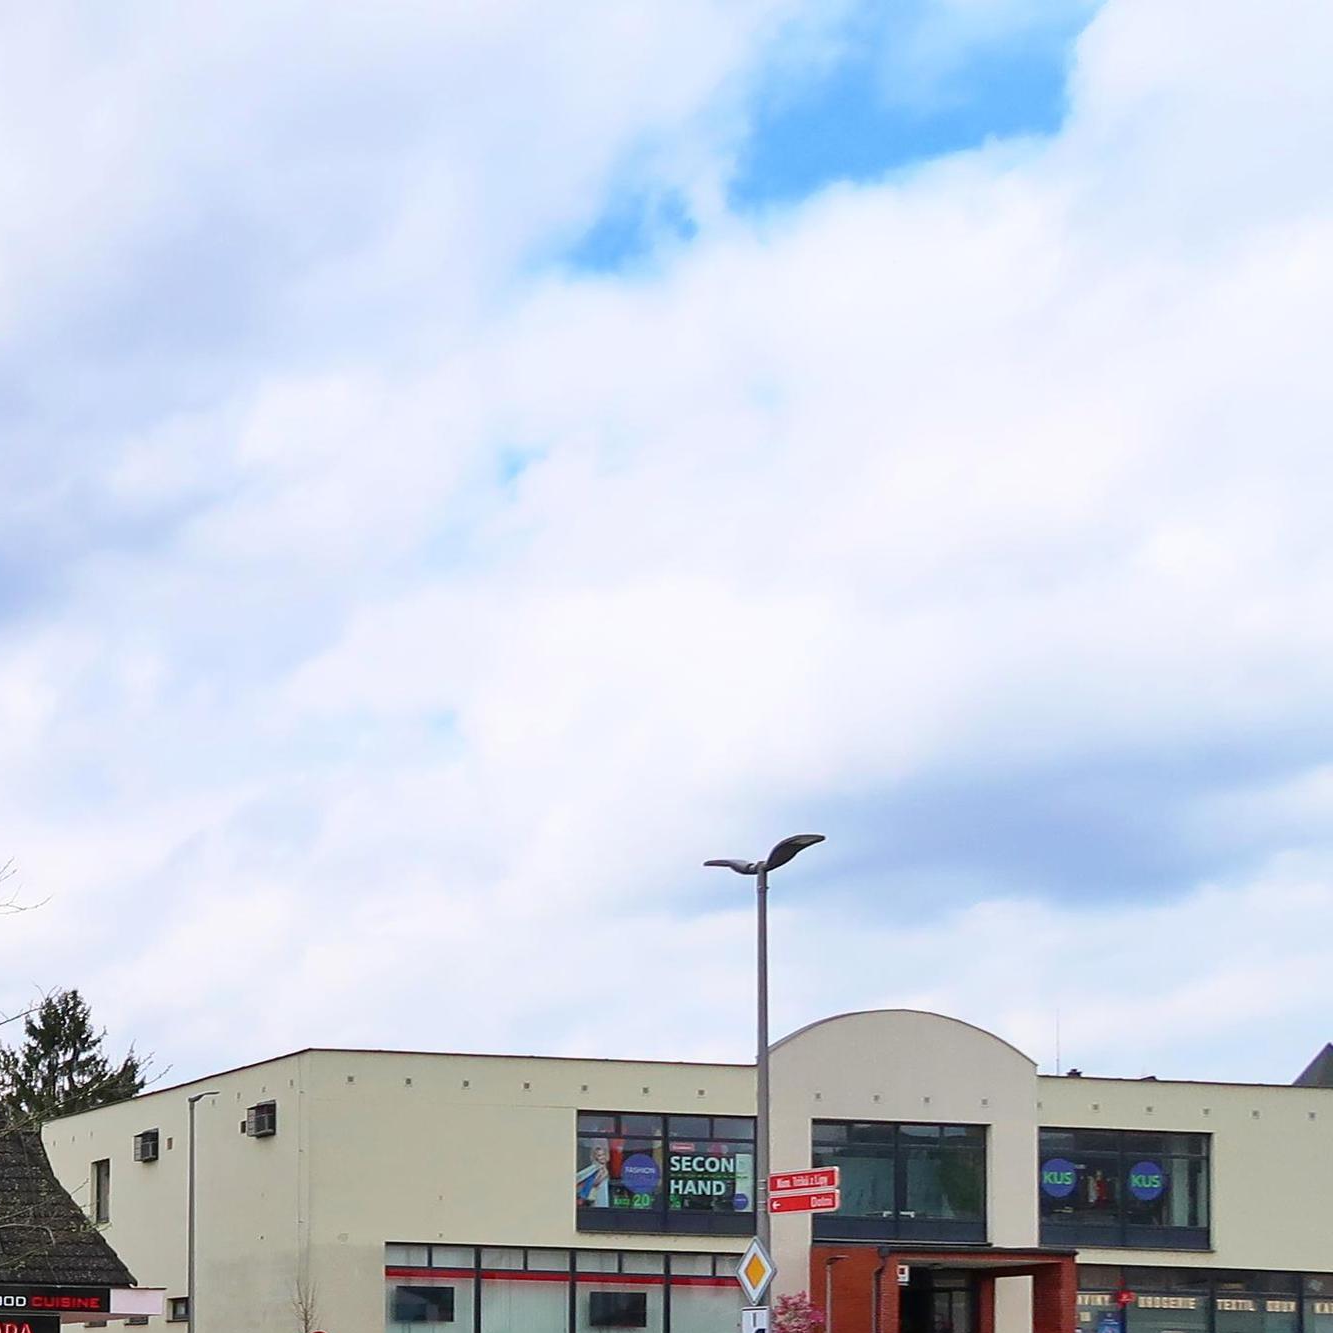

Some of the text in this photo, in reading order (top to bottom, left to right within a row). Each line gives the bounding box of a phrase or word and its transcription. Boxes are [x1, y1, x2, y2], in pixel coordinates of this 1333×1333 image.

[670, 1156, 749, 1172] SECON
[1043, 1172, 1073, 1184] KUS
[1132, 1175, 1161, 1188] KUS
[670, 1180, 726, 1196] HAND
[32, 1296, 101, 1309] CUISINE
